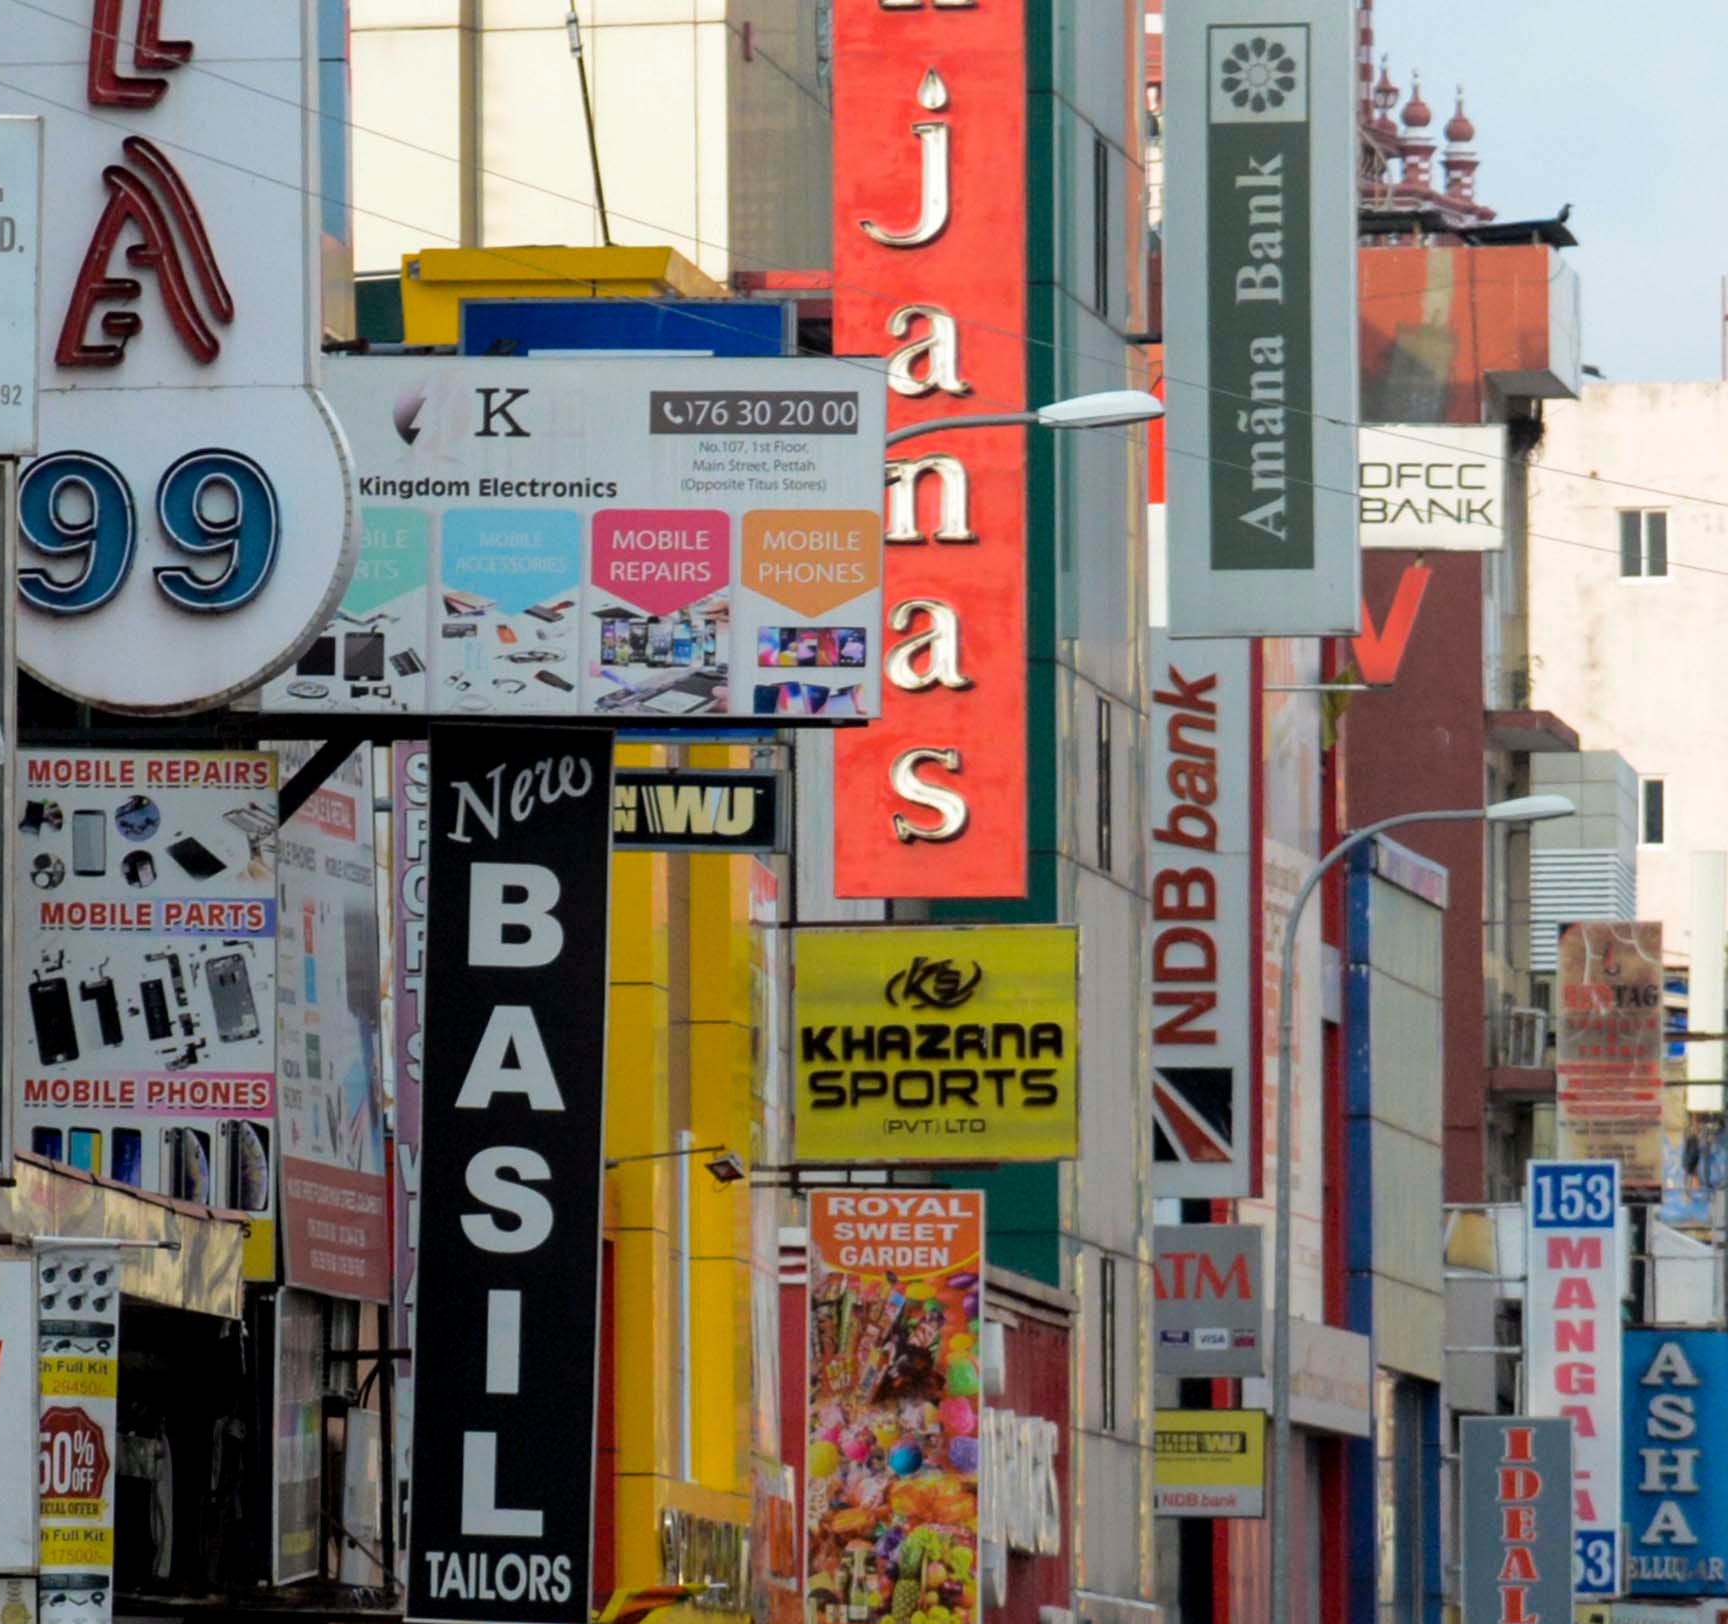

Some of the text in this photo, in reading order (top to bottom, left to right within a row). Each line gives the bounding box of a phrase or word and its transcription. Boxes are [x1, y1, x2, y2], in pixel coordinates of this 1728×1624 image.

[1237, 151, 1286, 304] Bank
[736, 401, 857, 426] 30 20 00
[693, 459, 725, 472] Main
[774, 459, 816, 472] Pettah
[360, 476, 618, 499] Kingdom Electronics
[611, 530, 710, 552] MOBILE
[763, 530, 862, 551] MOBILE
[609, 560, 712, 584] REPAIRS
[758, 562, 866, 584] PHONES
[27, 760, 270, 788] MOBILE REPAIRS
[447, 755, 593, 845] New
[39, 902, 265, 932] MOBILE PARTS
[1153, 867, 1218, 1045] NDB
[801, 1022, 1064, 1063] KHAZANA
[24, 1078, 268, 1108] MOBILE PHONES
[809, 1068, 1059, 1110] SPORTS
[945, 1118, 987, 1134] LTD
[455, 861, 568, 1538] BASIL
[827, 1197, 974, 1218] ROYAL
[1535, 1174, 1611, 1222] 153
[833, 1223, 960, 1242] SWEET
[839, 1246, 949, 1267] GARDEN
[57, 1360, 109, 1375] Full Kit
[1638, 1342, 1700, 1546] ASHA
[73, 1467, 95, 1492] OFF
[84, 1529, 105, 1542] Kit
[425, 1551, 572, 1602] TAILORS
